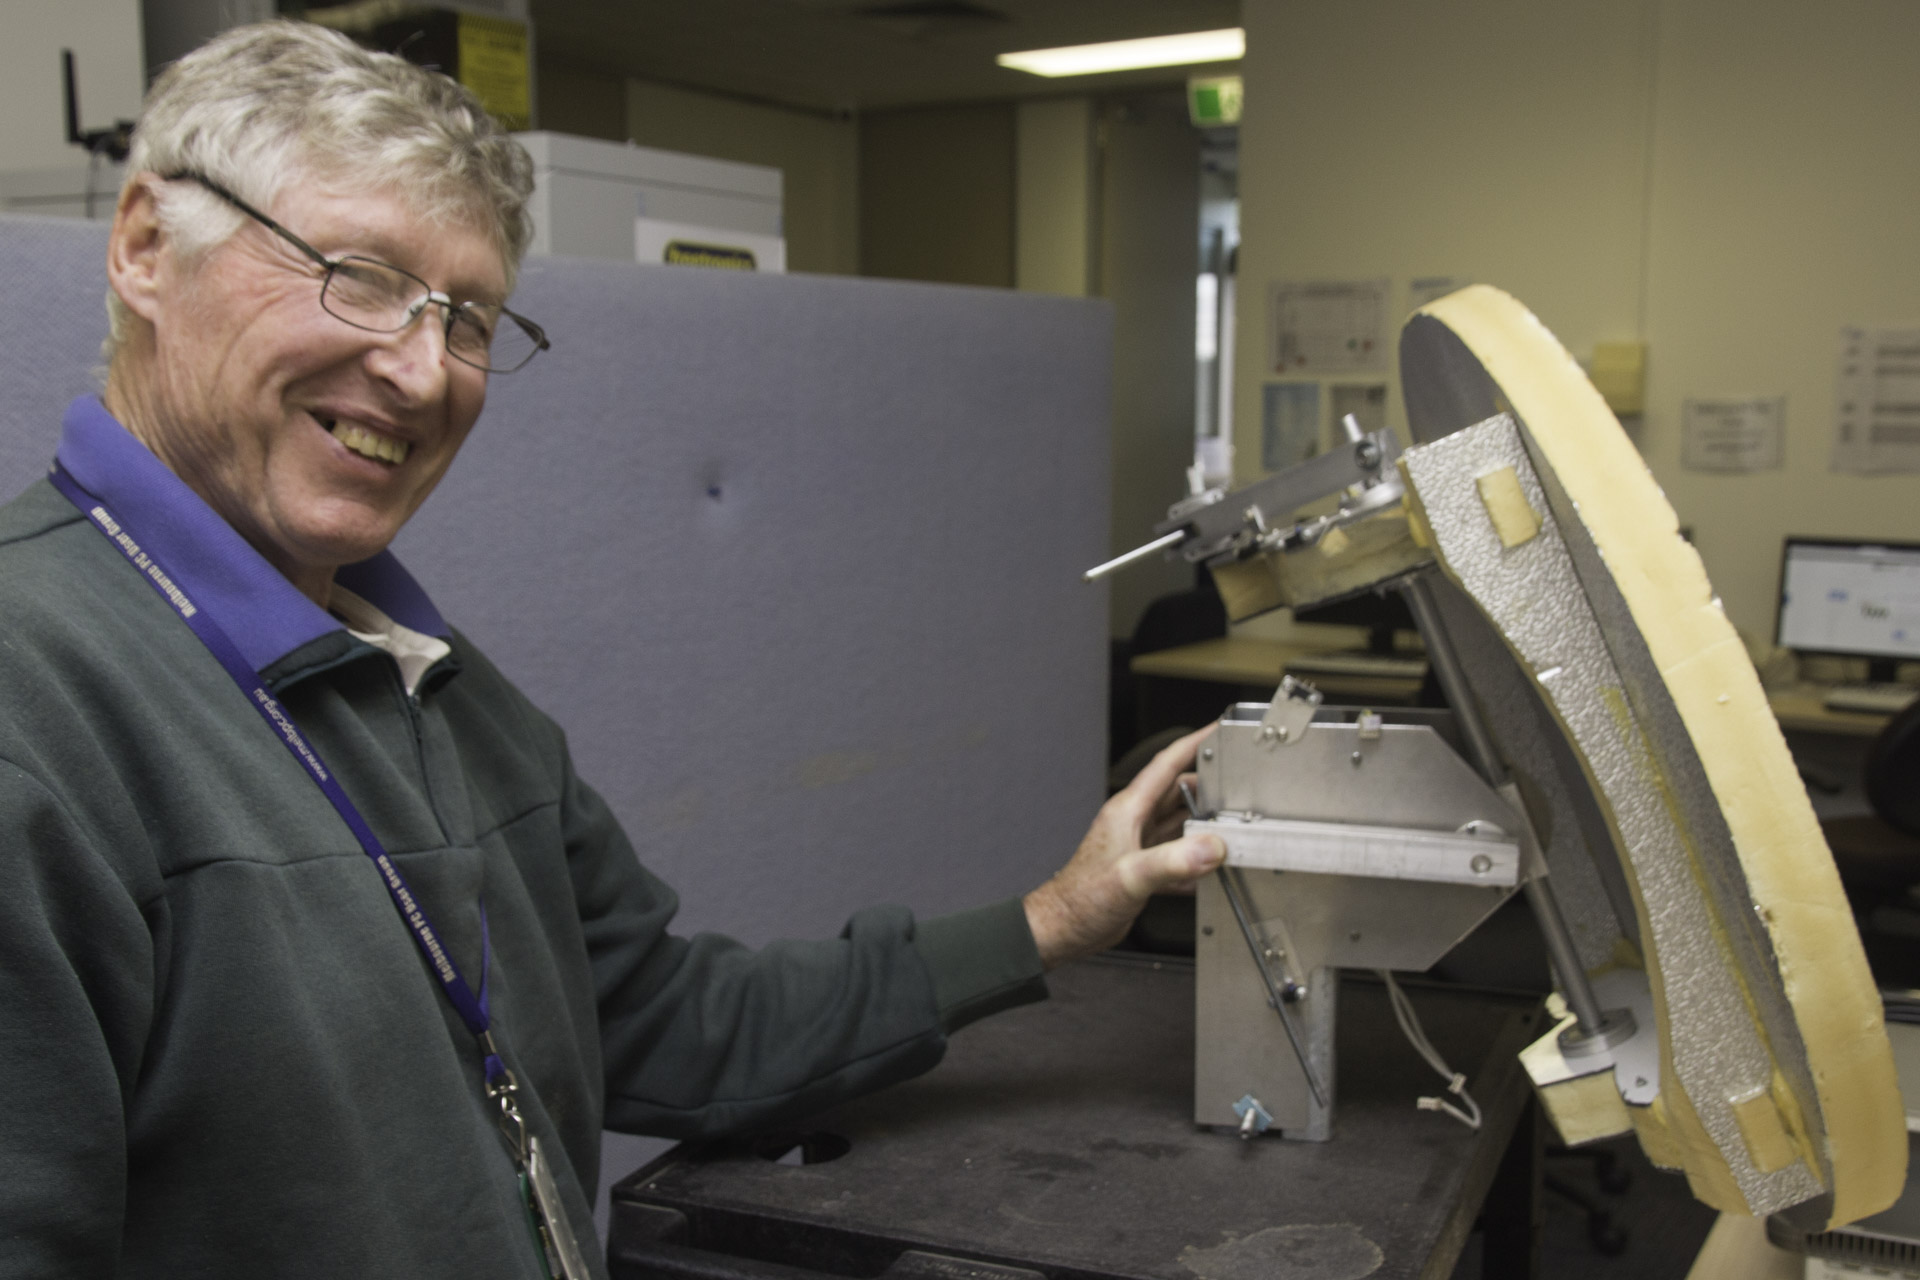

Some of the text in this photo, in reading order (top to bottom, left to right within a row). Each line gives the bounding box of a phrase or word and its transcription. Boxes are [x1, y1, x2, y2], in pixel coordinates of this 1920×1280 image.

[91, 506, 197, 618] Melbourne PC User Group
[253, 688, 328, 782] www.melbpc.org.au
[397, 887, 417, 914] User
[410, 911, 426, 929] PC
[420, 926, 456, 983] Melbourne
